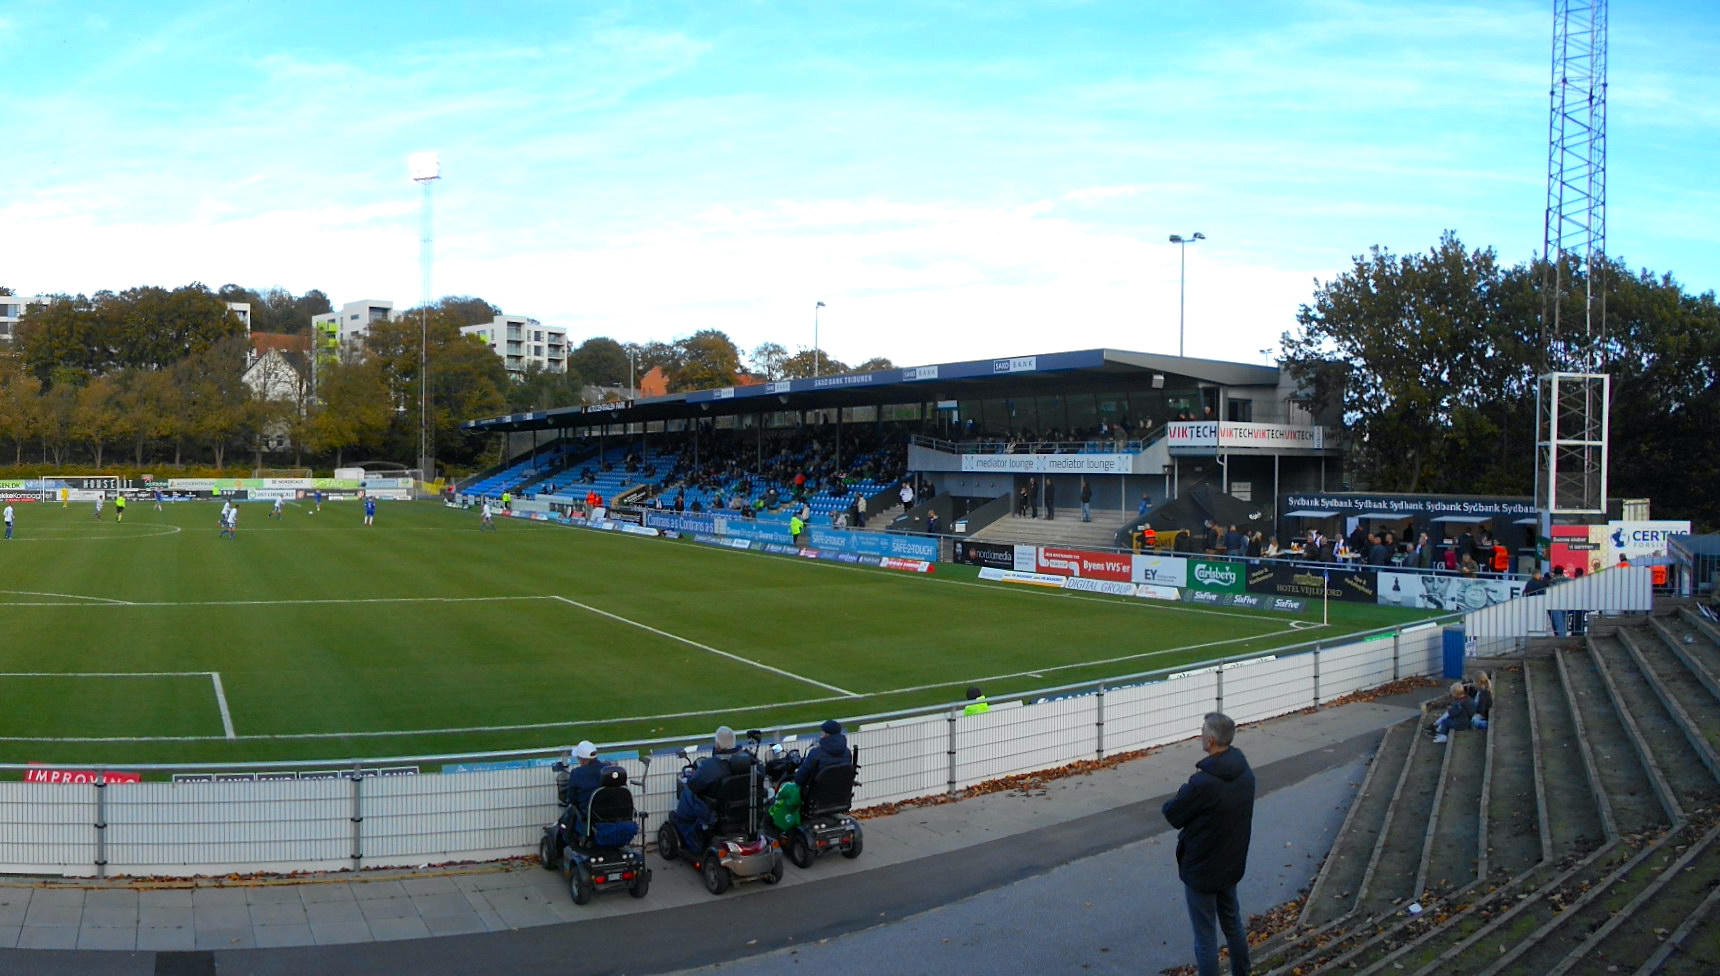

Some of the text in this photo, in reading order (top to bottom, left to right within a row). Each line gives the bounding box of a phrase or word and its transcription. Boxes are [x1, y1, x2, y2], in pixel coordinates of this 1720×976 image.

[995, 360, 1033, 370] SAXO BANK
[1168, 426, 1217, 441] VIKTECH
[977, 458, 1034, 470] mediator lounge
[1050, 458, 1115, 472] mediator lounge
[1288, 497, 1320, 507] Sydbank
[1320, 498, 1353, 508] Sydbank
[1354, 499, 1388, 510] Sydbank
[1390, 500, 1424, 510] Sydbank
[1426, 501, 1462, 512] Sydbank
[1463, 502, 1500, 513] Sydbank
[1083, 560, 1104, 572] Byens
[1144, 569, 1158, 580] EY
[1194, 564, 1237, 584] Carlsberg
[1067, 578, 1132, 594] DIGITAL GROUP
